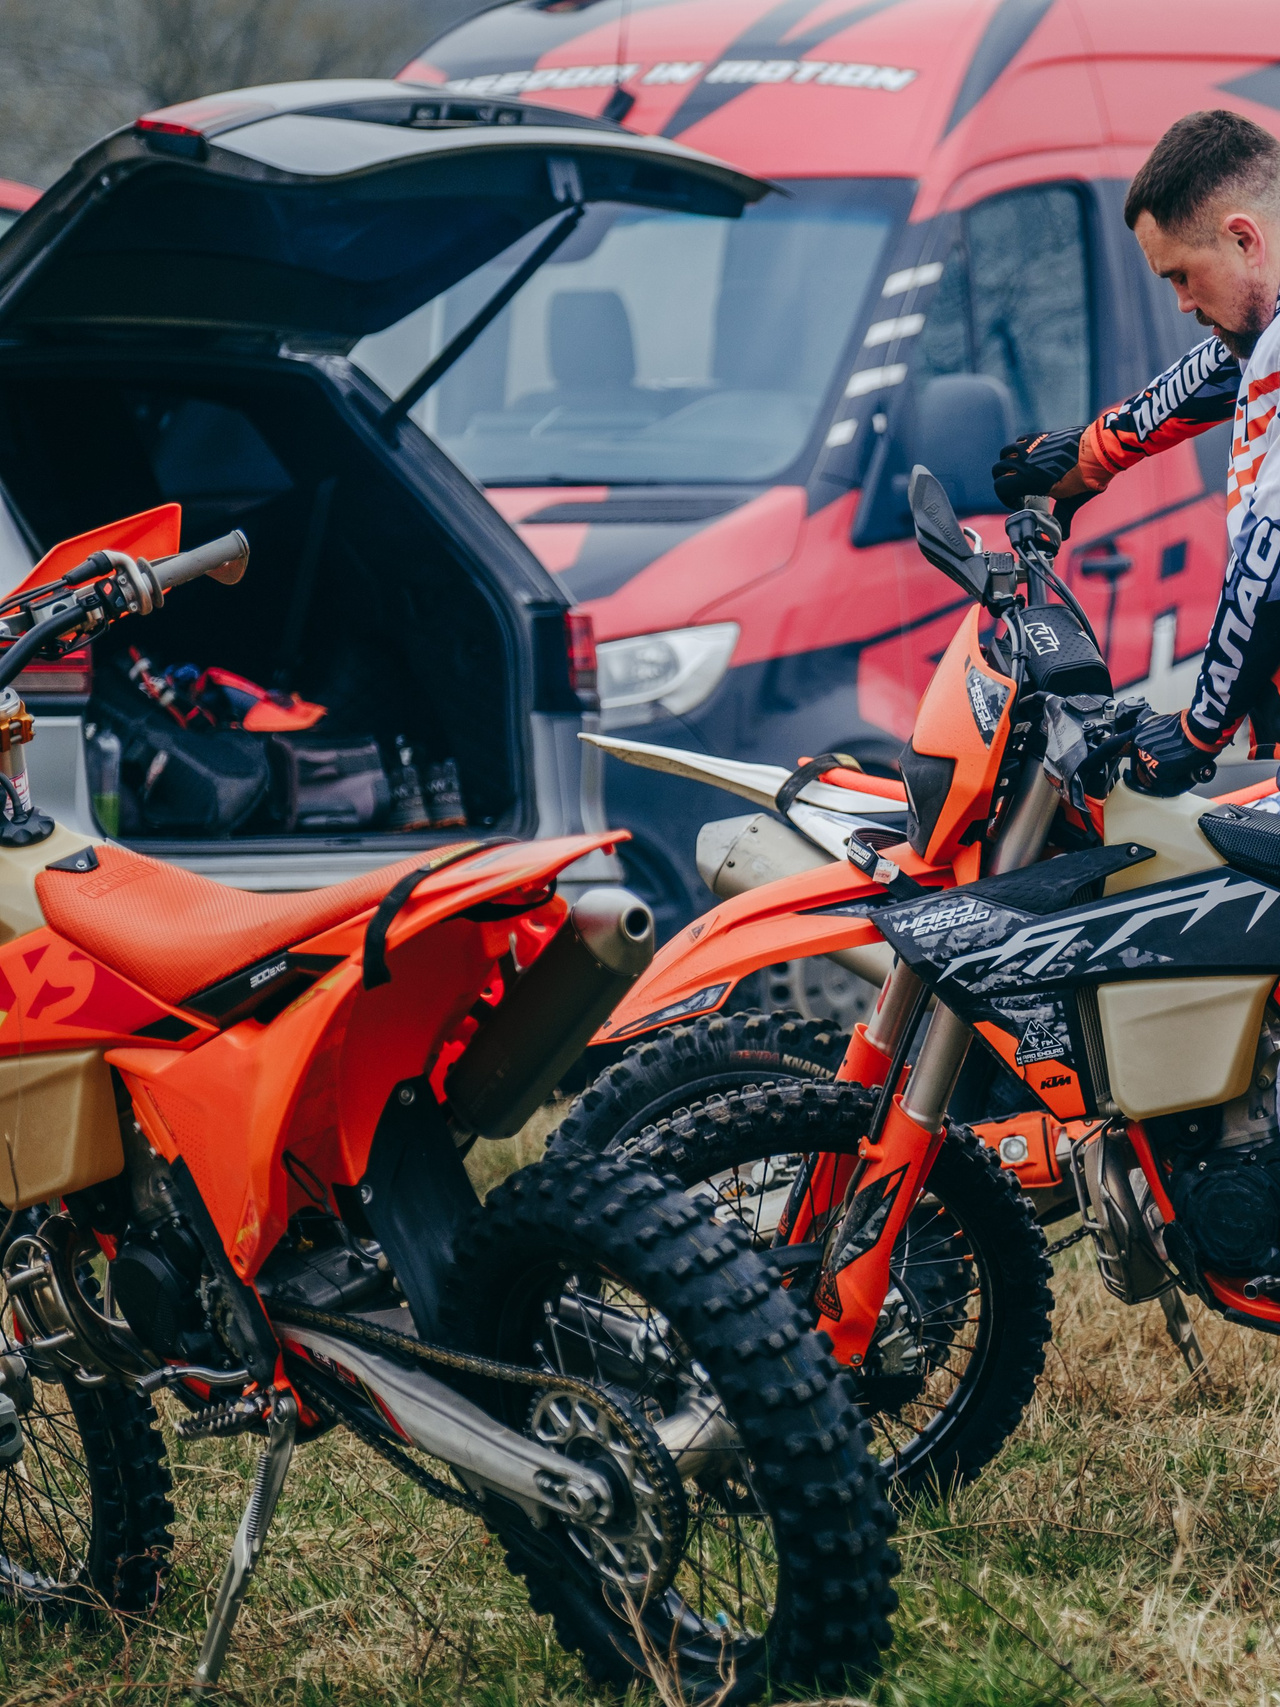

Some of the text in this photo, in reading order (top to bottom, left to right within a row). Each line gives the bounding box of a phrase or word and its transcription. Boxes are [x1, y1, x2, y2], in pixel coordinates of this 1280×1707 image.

[642, 61, 702, 84] IN
[704, 60, 917, 92] MOTION
[1132, 340, 1232, 441] ENDURO
[1024, 622, 1060, 656] KTM
[897, 902, 977, 933] HARD
[912, 909, 991, 937] ENDURO
[782, 1054, 835, 1080] KNARLY
[1040, 1075, 1071, 1089] KTM
